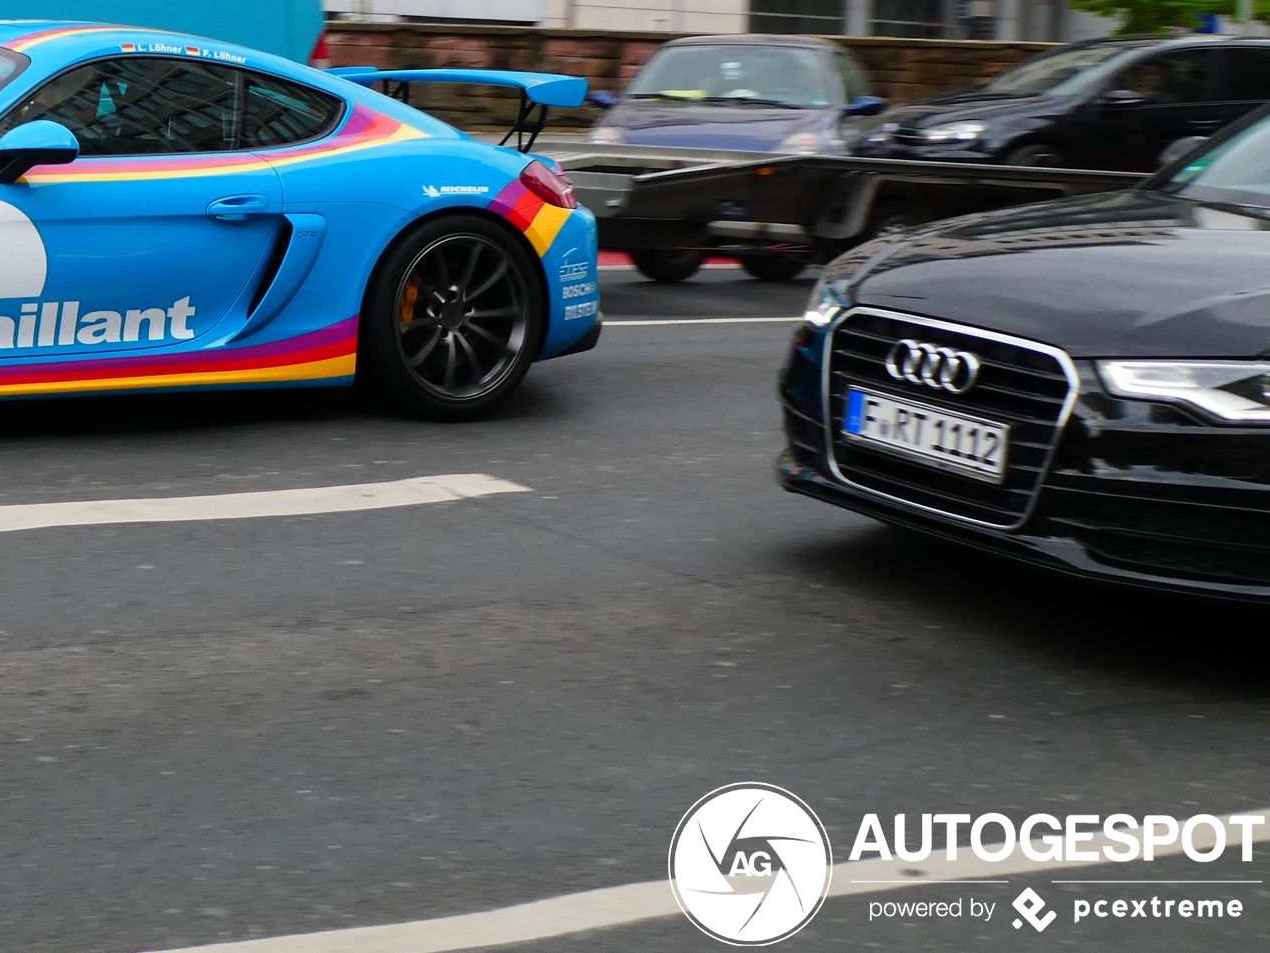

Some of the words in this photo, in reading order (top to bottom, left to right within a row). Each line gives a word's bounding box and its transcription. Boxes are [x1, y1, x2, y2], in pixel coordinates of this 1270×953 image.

[137, 43, 147, 52] L.
[149, 43, 182, 54] Löhner
[202, 49, 212, 58] F.
[214, 49, 247, 65] Löhner
[439, 185, 490, 193] MICHELIN
[864, 399, 881, 434] F
[893, 407, 928, 447] RT
[930, 419, 1000, 467] 1112
